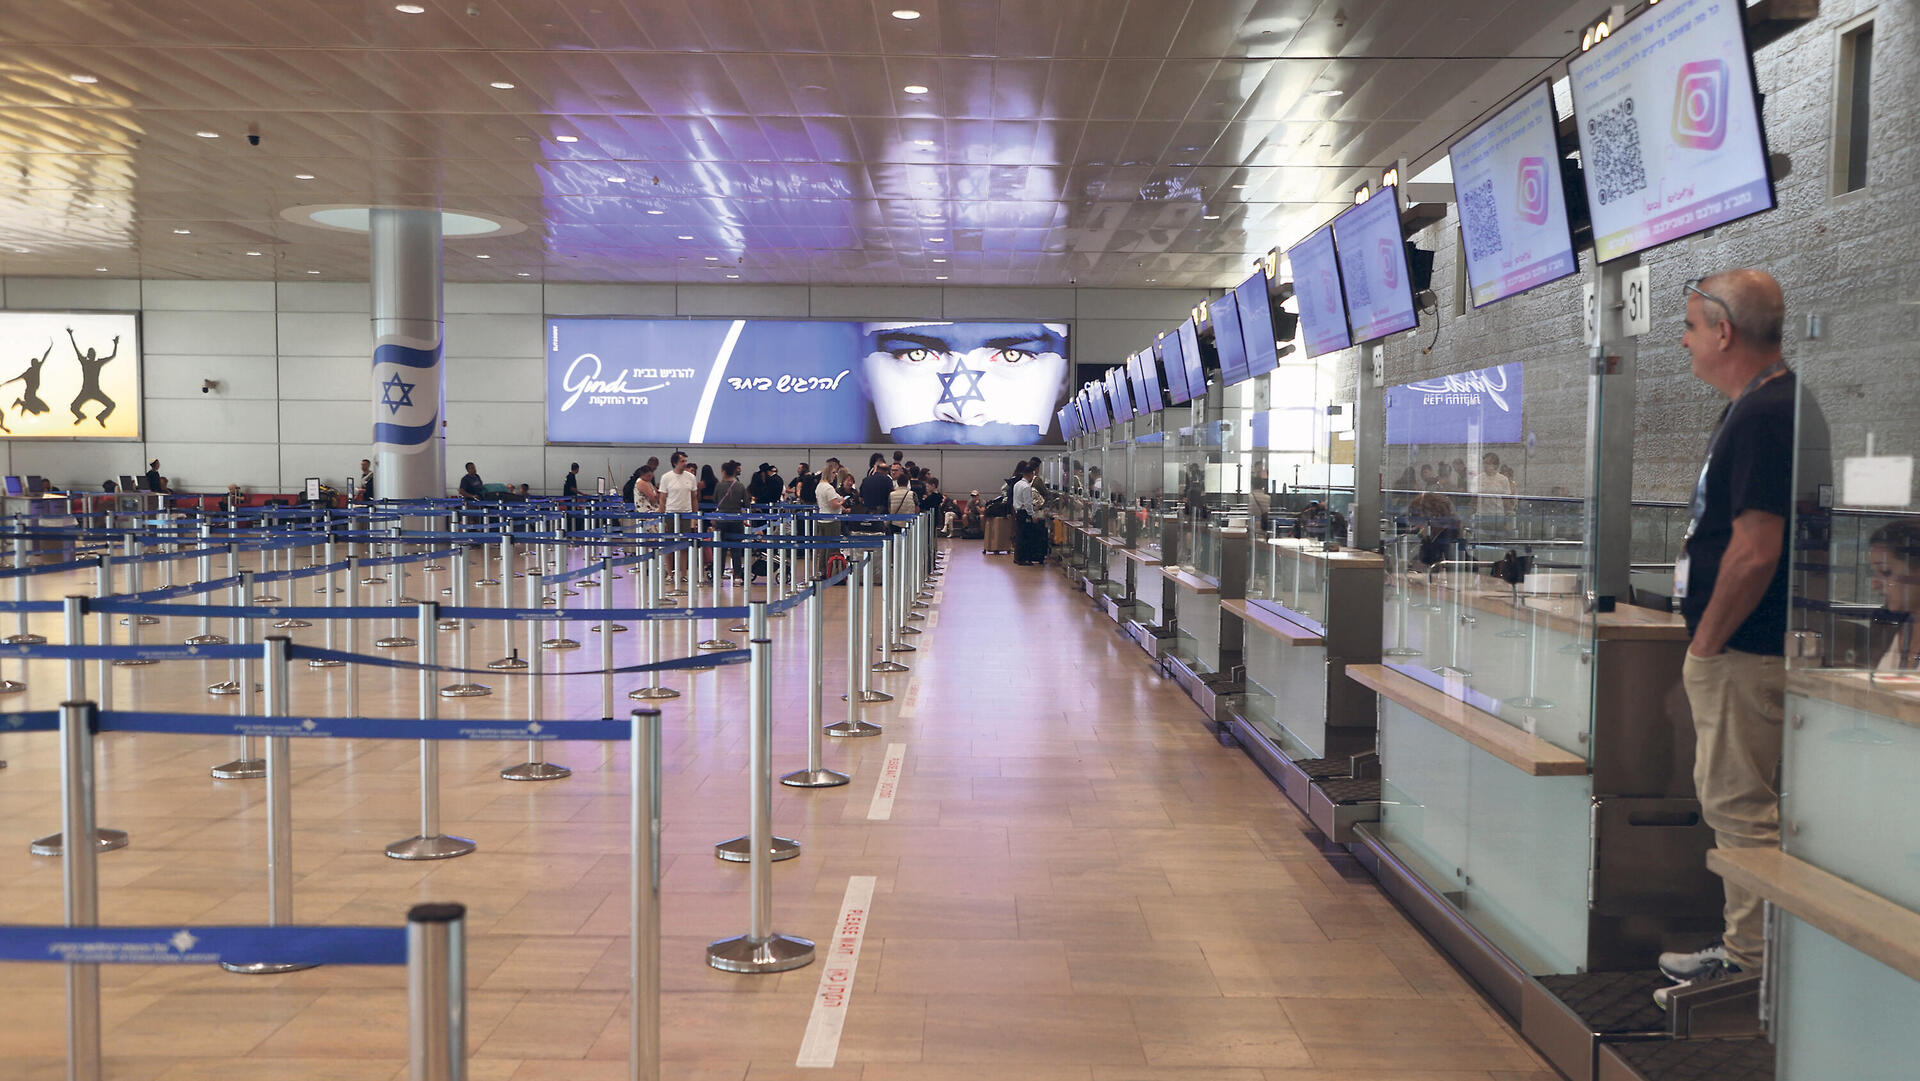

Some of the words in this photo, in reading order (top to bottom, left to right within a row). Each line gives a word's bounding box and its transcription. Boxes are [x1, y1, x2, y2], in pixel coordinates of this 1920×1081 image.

[1629, 281, 1643, 322] 31
[633, 367, 658, 378] בבית
[660, 367, 695, 379] להרגיש
[728, 377, 773, 391] ביחד
[776, 369, 850, 393] להרגיש
[588, 396, 626, 406] החזקות
